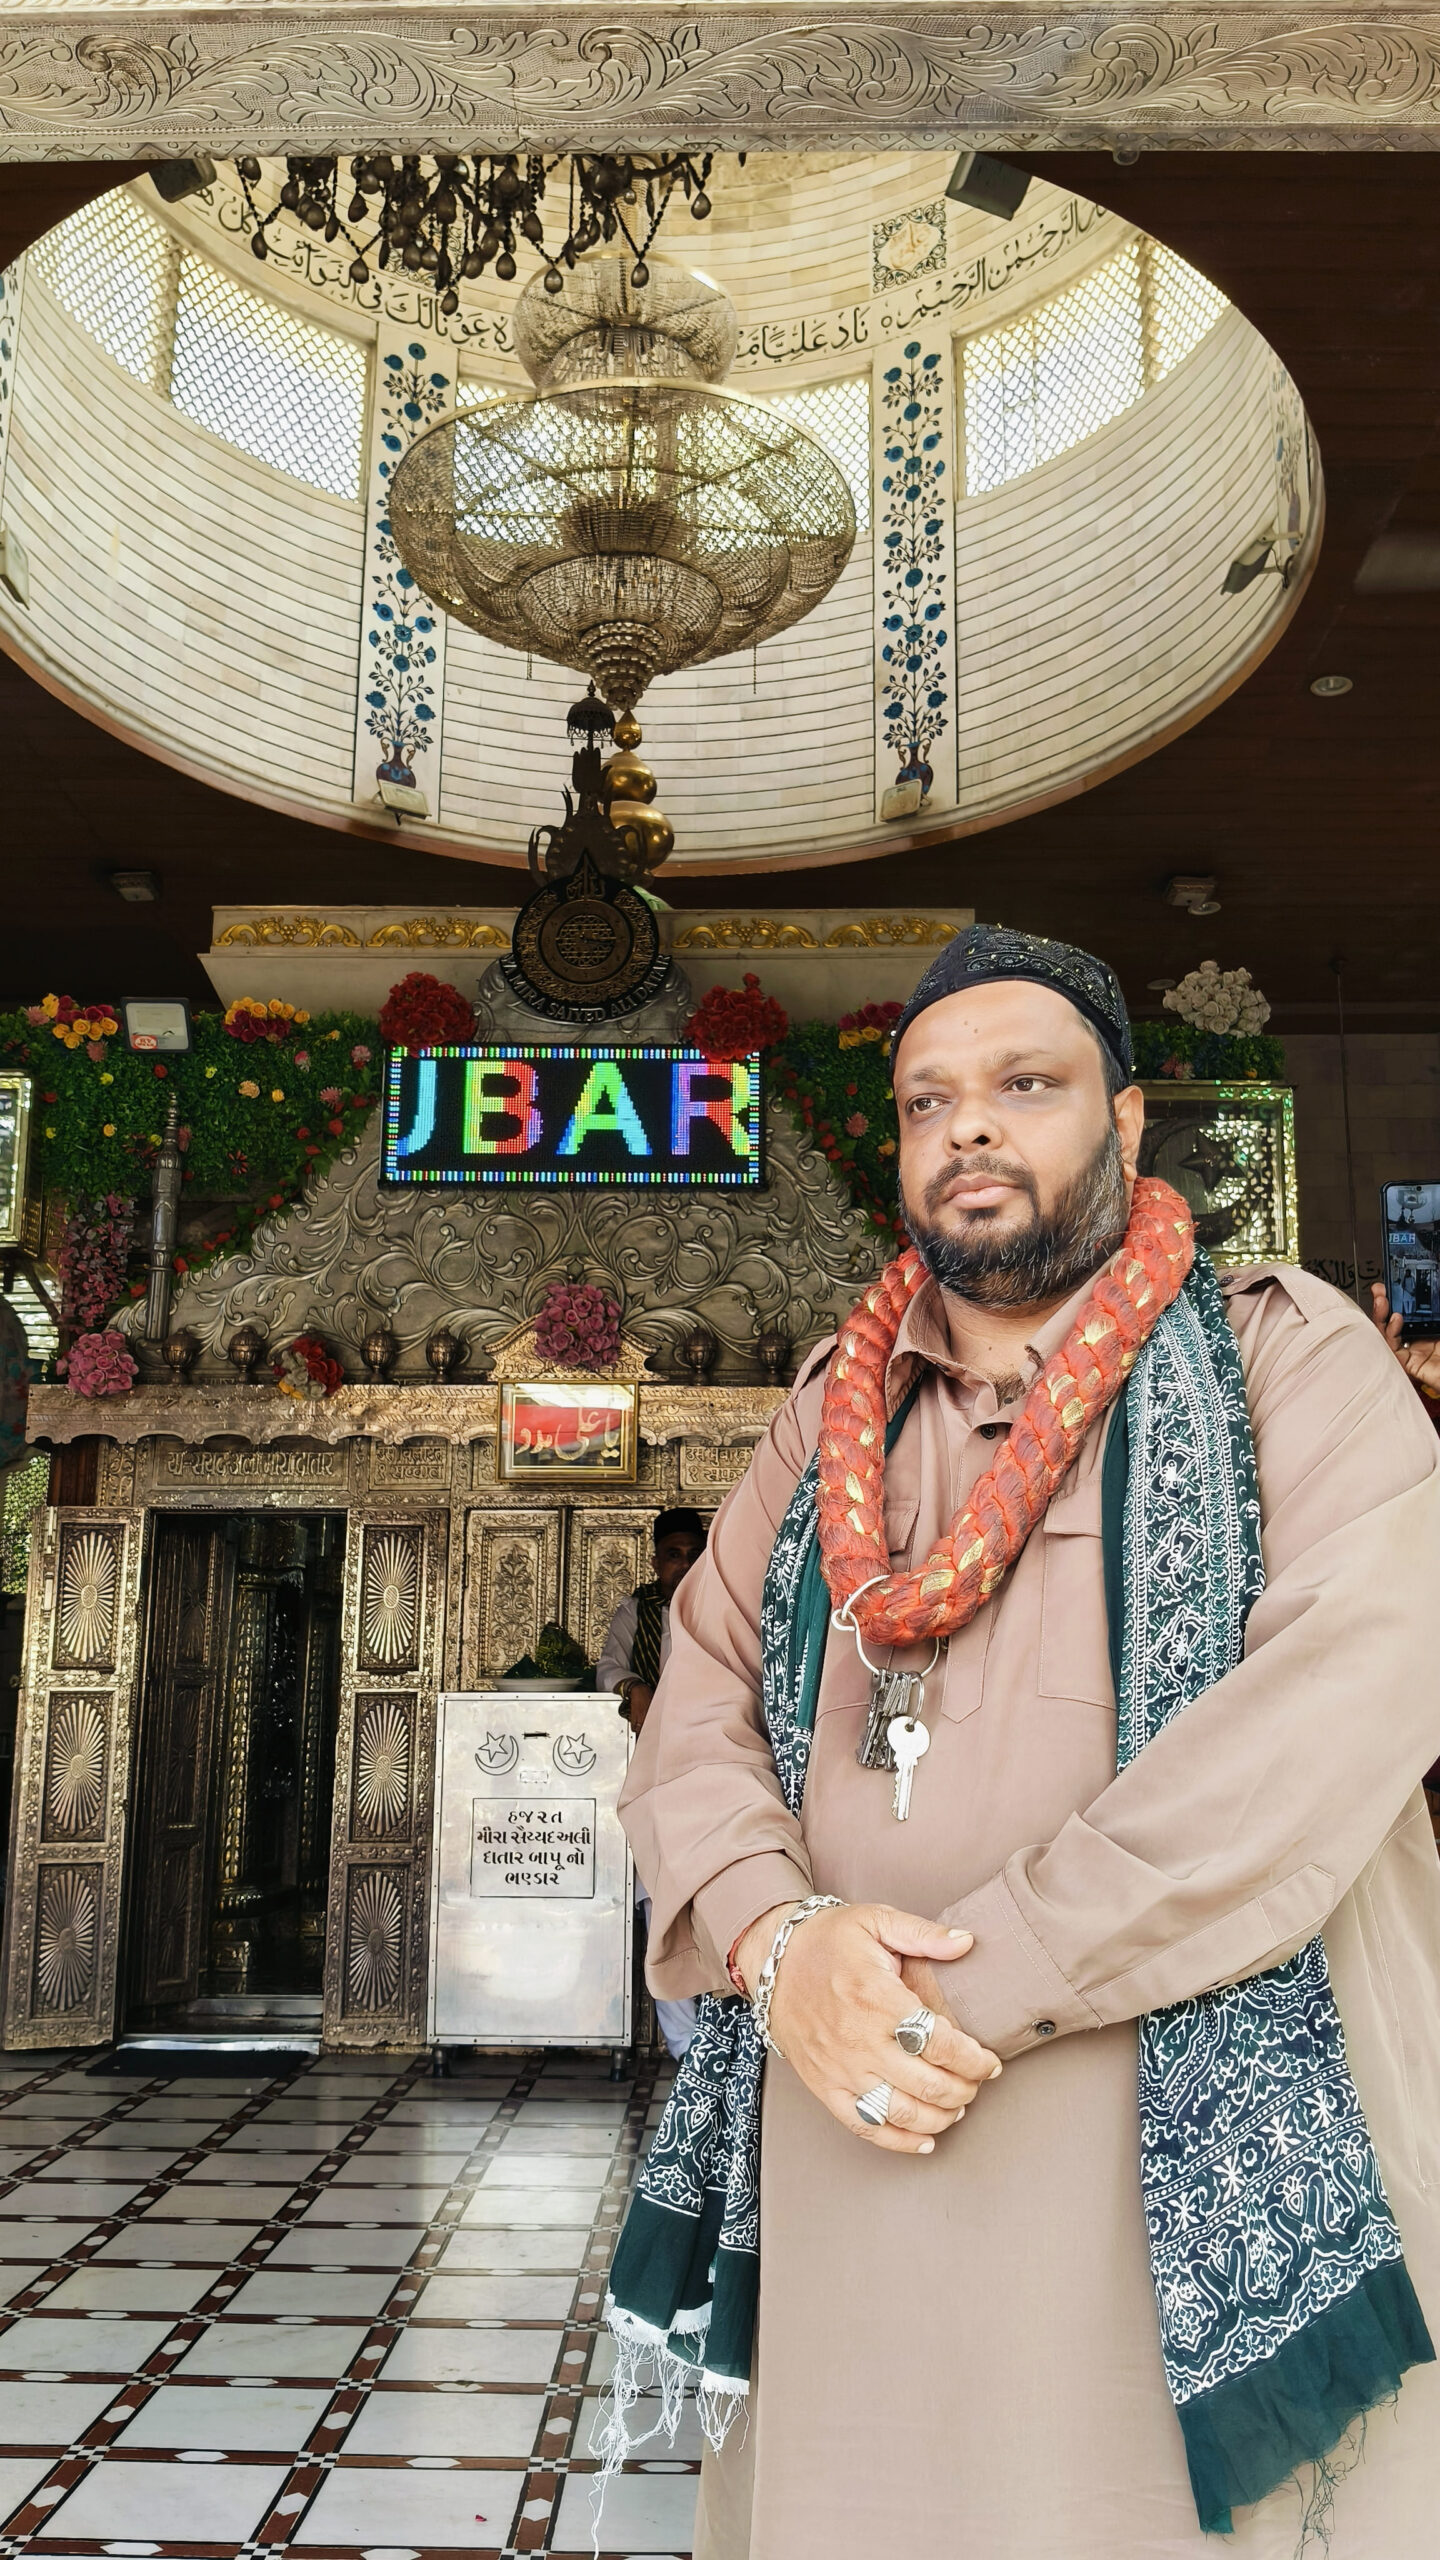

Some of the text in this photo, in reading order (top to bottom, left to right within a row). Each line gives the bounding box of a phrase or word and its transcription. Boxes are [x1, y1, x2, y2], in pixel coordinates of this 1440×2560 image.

[610, 994, 638, 1018] ALI
[477, 1826, 507, 1844] મીરા
[483, 1851, 524, 1865] દાતાર
